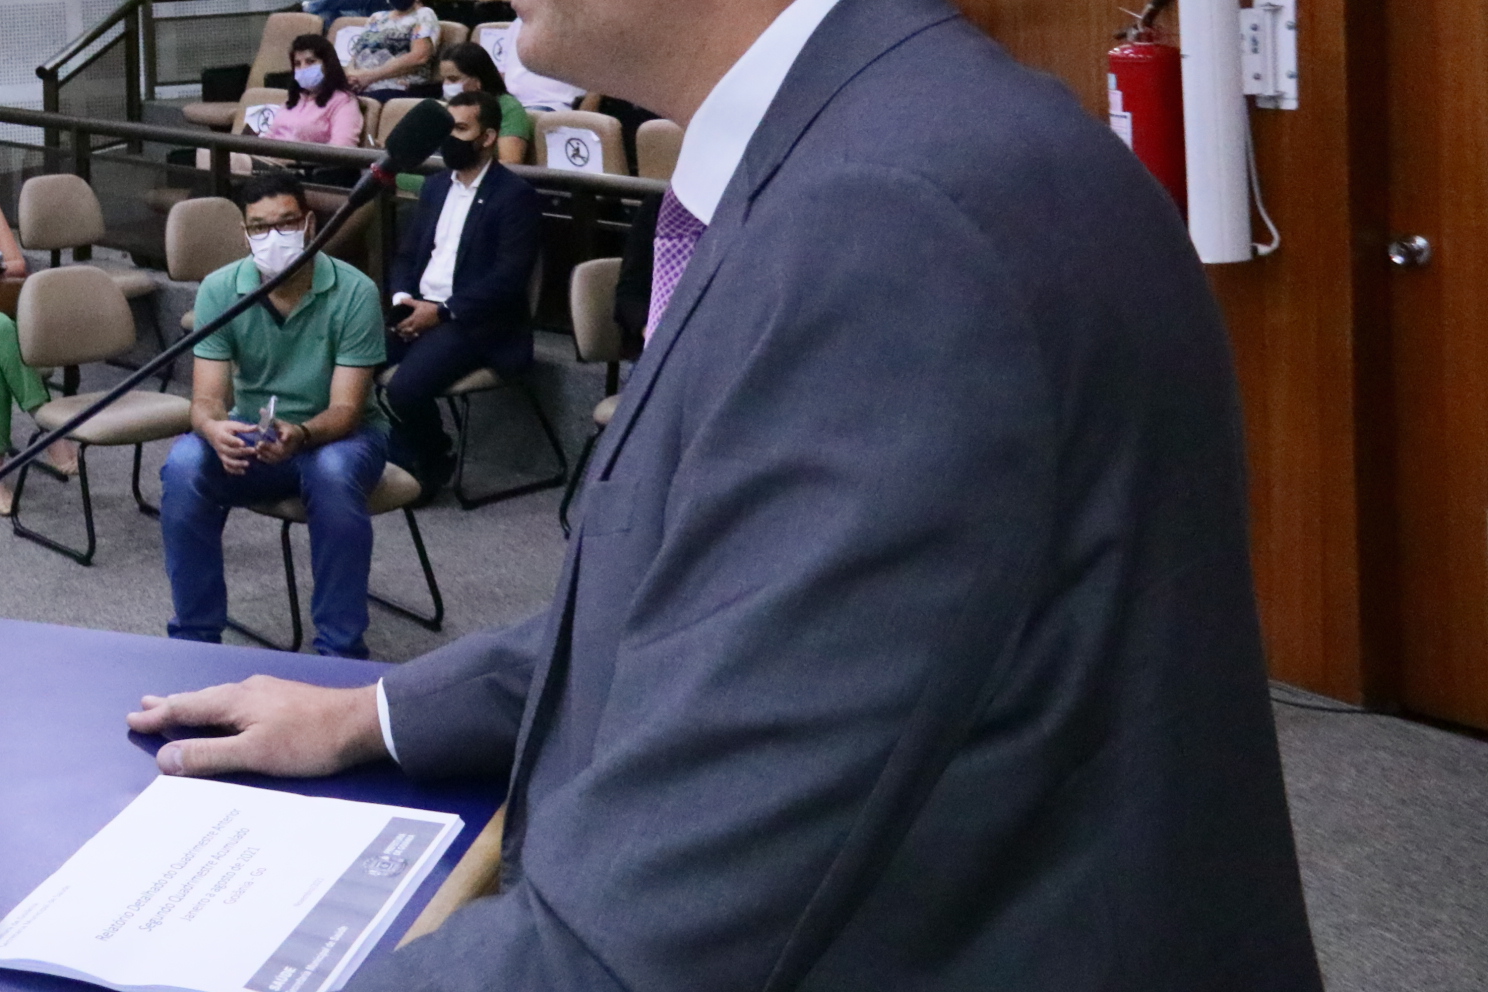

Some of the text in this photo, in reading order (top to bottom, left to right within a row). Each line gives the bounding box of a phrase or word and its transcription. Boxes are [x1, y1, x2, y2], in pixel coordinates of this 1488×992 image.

[231, 859, 245, 872] de
[236, 846, 261, 863] 2021
[94, 911, 134, 941] Relatório
[126, 879, 168, 912] Detalhado
[162, 868, 177, 880] do
[170, 830, 218, 870] Quadrimestre
[211, 808, 241, 832] Anterior
[138, 827, 250, 932] Segundo Quadrimestre Acumulado
[210, 870, 236, 893] agosto
[223, 879, 254, 905] Goiânia
[179, 896, 210, 922] Janeiro
[268, 966, 297, 991] SAÚDE
